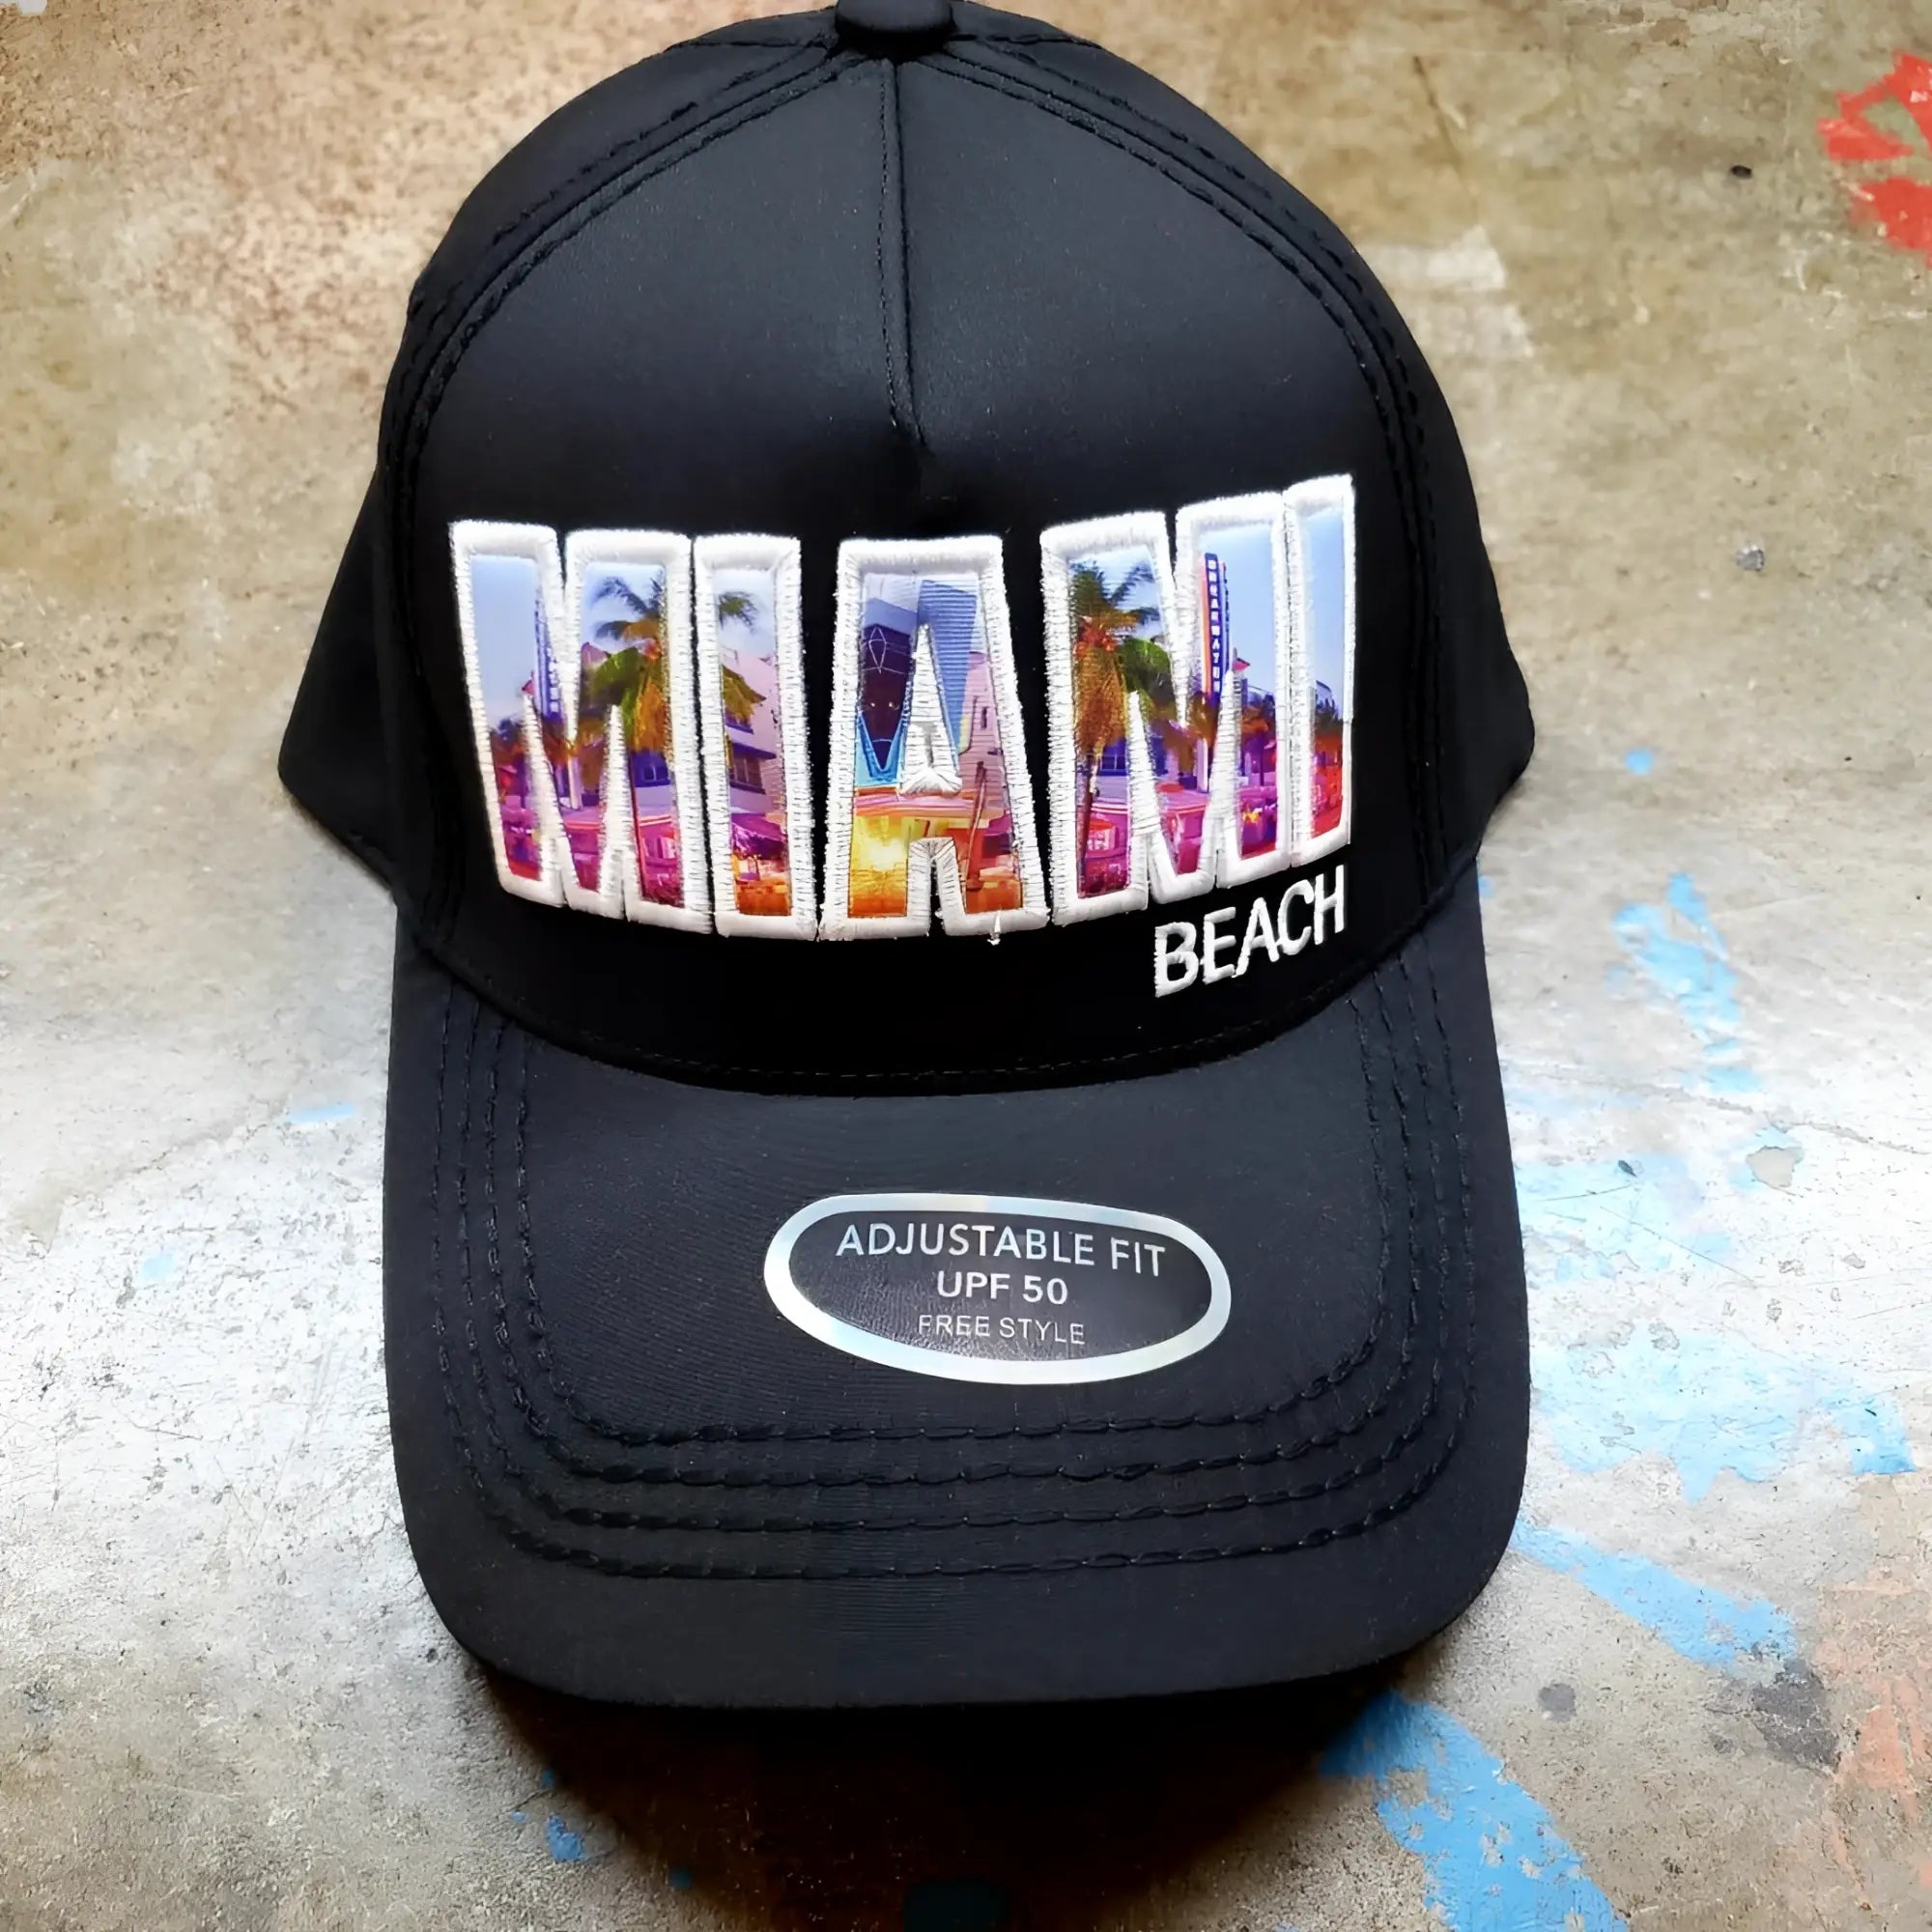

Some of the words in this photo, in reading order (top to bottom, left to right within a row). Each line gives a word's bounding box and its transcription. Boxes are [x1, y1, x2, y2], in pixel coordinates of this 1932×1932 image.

[448, 473, 1357, 942] MIAMI
[1153, 864, 1346, 997] BEACH
[837, 1223, 1094, 1265] ADJUSTABLE
[1110, 1236, 1166, 1277] FIT
[936, 1270, 1010, 1300] UPF
[1022, 1274, 1068, 1306] 50
[918, 1315, 990, 1338] FREE
[999, 1317, 1086, 1346] STYLE
